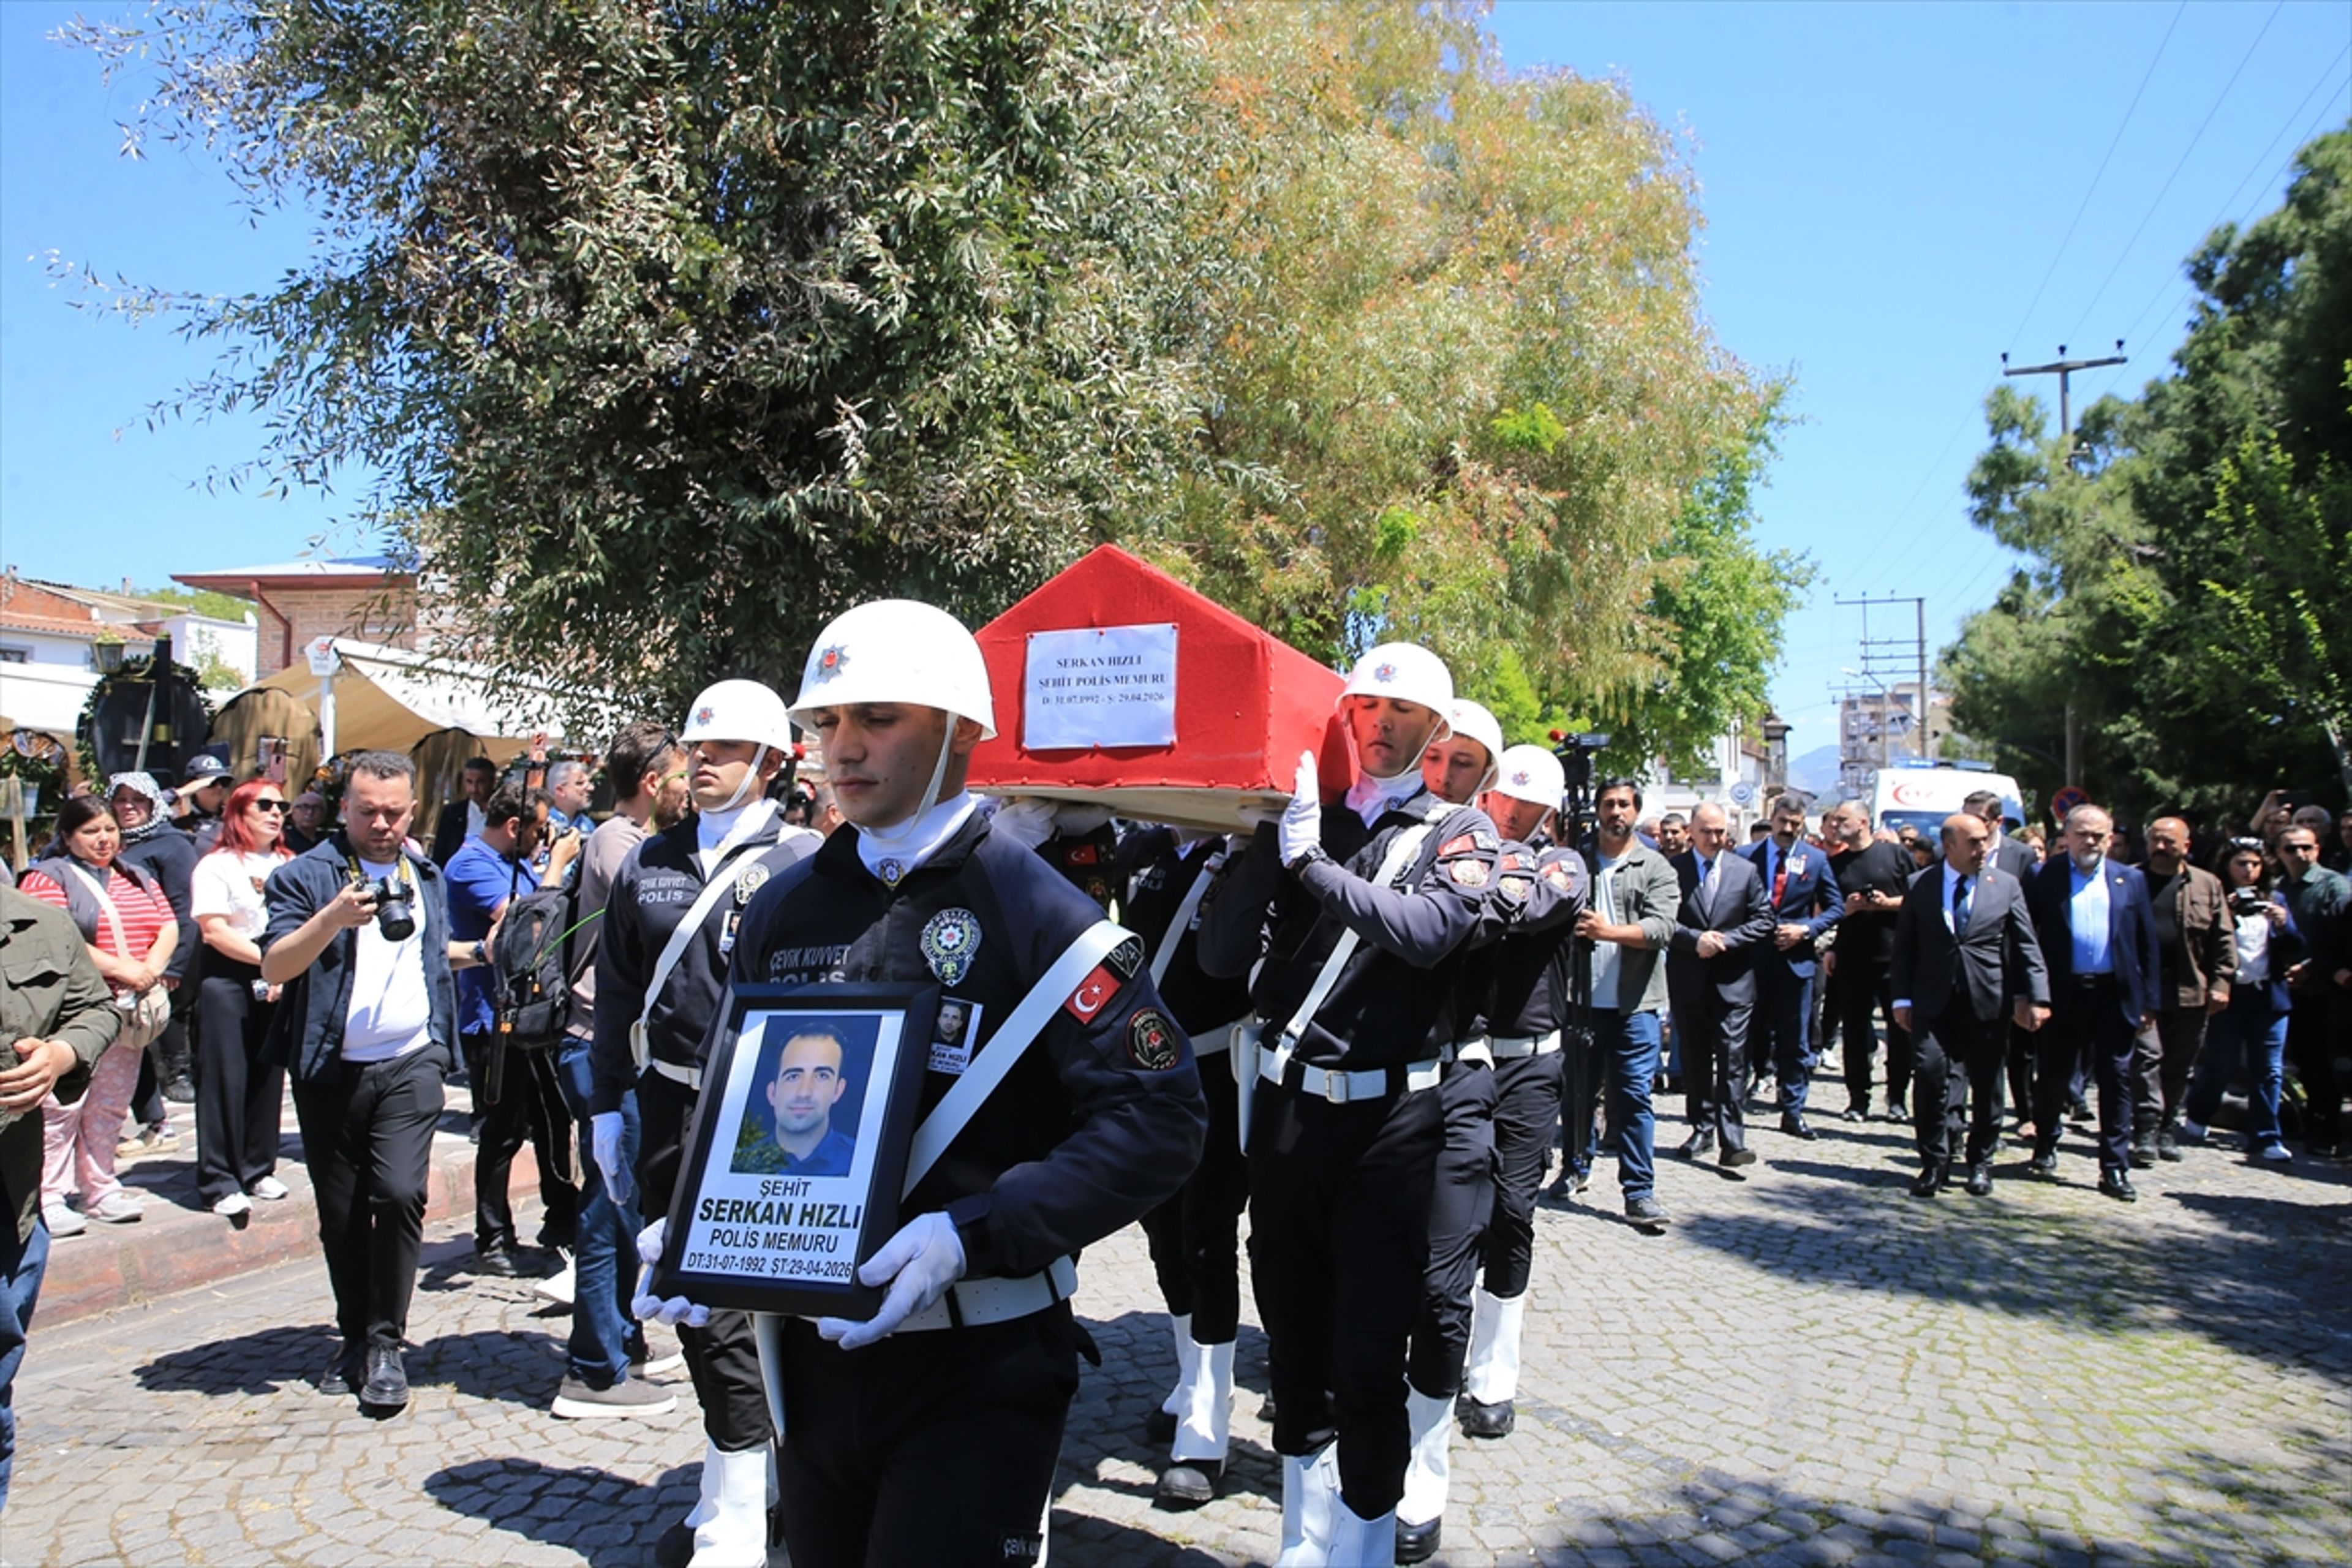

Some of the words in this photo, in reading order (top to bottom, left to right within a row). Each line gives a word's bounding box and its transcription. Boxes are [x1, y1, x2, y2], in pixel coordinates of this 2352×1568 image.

[1057, 657, 1104, 668] SERKAN
[1039, 676, 1071, 690] ŞEHİT
[1076, 674, 1110, 687] POLİS
[1114, 673, 1168, 685] MEMURU
[1118, 692, 1164, 702] 29.04.2026
[760, 1178, 812, 1199] ŞEHİT
[699, 1198, 794, 1226] SERKAN
[799, 1203, 862, 1229] HIZLI
[709, 1226, 760, 1249] POLİS
[762, 1232, 839, 1253] MEMURU
[687, 1253, 767, 1273] DT:31-07-1992
[771, 1257, 853, 1278] ŞT:29-04-2026
